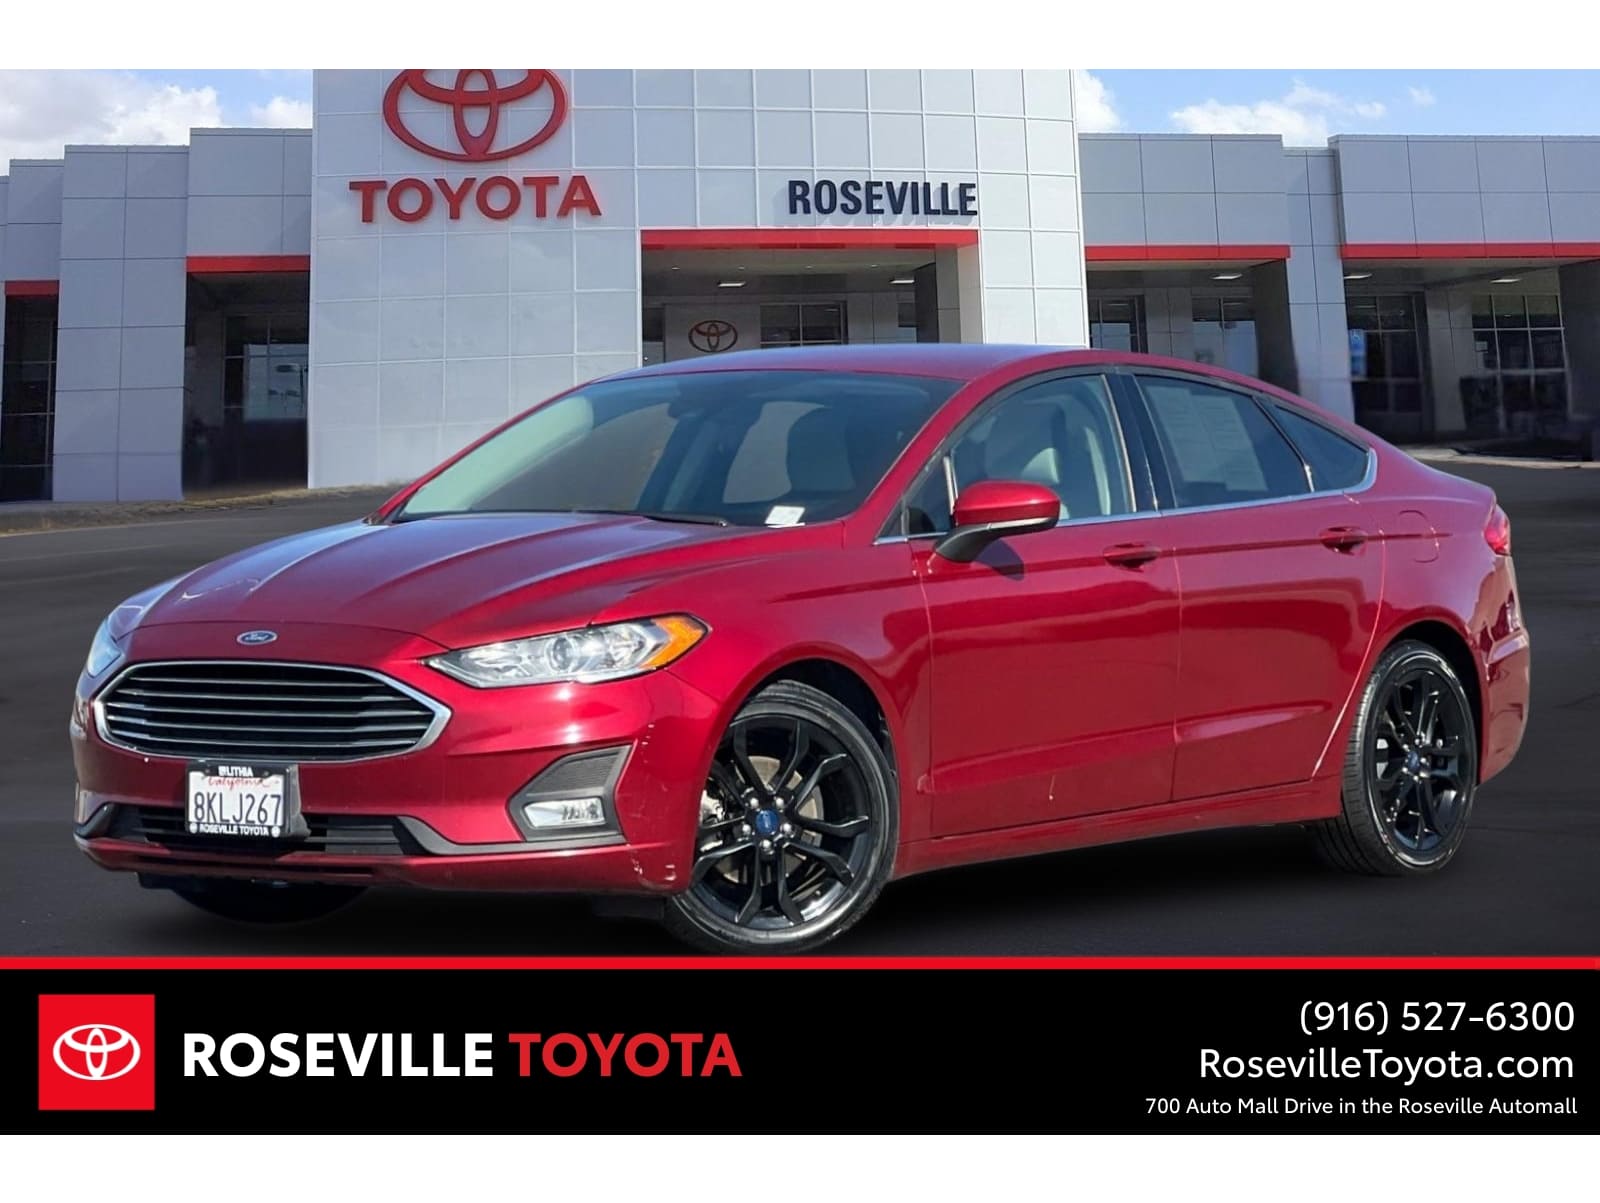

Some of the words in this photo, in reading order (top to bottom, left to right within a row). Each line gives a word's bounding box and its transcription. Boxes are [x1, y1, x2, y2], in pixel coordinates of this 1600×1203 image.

[349, 175, 602, 223] TOYOTA
[788, 179, 978, 217] ROSEVILLE
[194, 792, 281, 825] 8KLJ267
